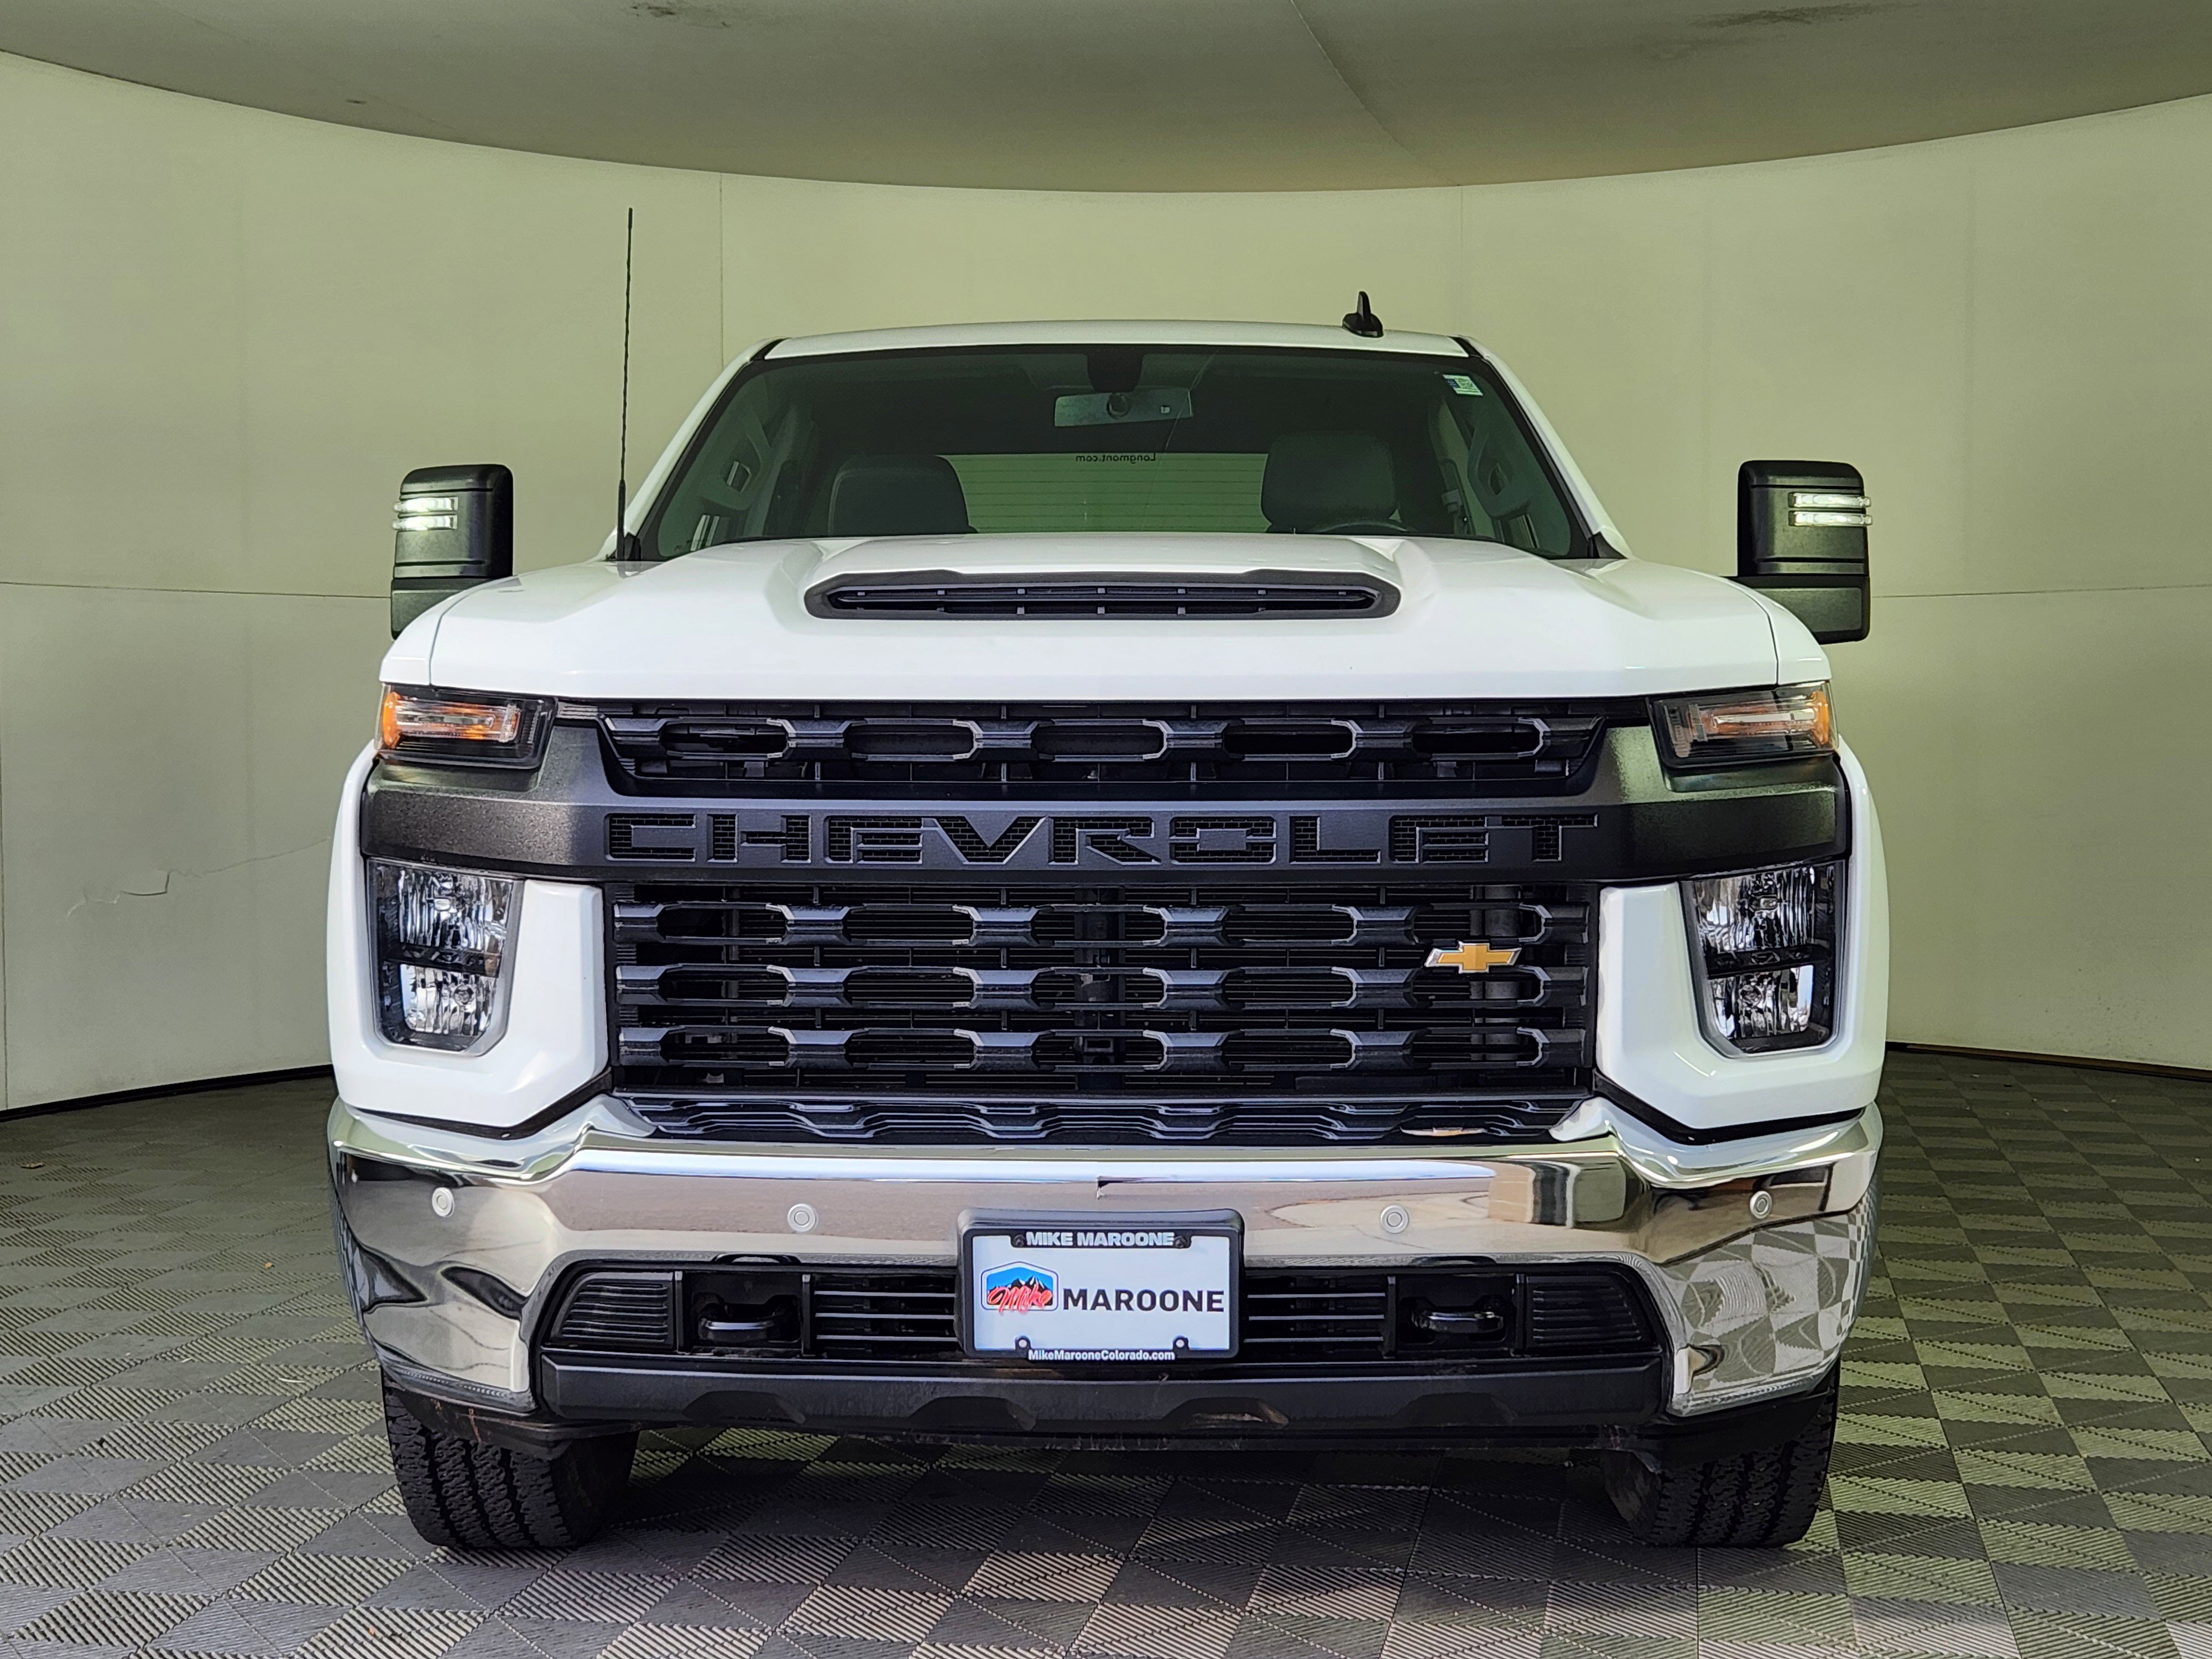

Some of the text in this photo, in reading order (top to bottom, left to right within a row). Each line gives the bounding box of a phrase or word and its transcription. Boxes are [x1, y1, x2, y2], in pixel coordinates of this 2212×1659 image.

[604, 813, 1598, 864] CHEVROLET
[1026, 1232, 1175, 1246] MIKE MAROONE
[988, 1285, 1053, 1313] Mike
[1063, 1288, 1224, 1312] MAROONE
[1028, 1350, 1176, 1361] MikeMarooneColorado.com
